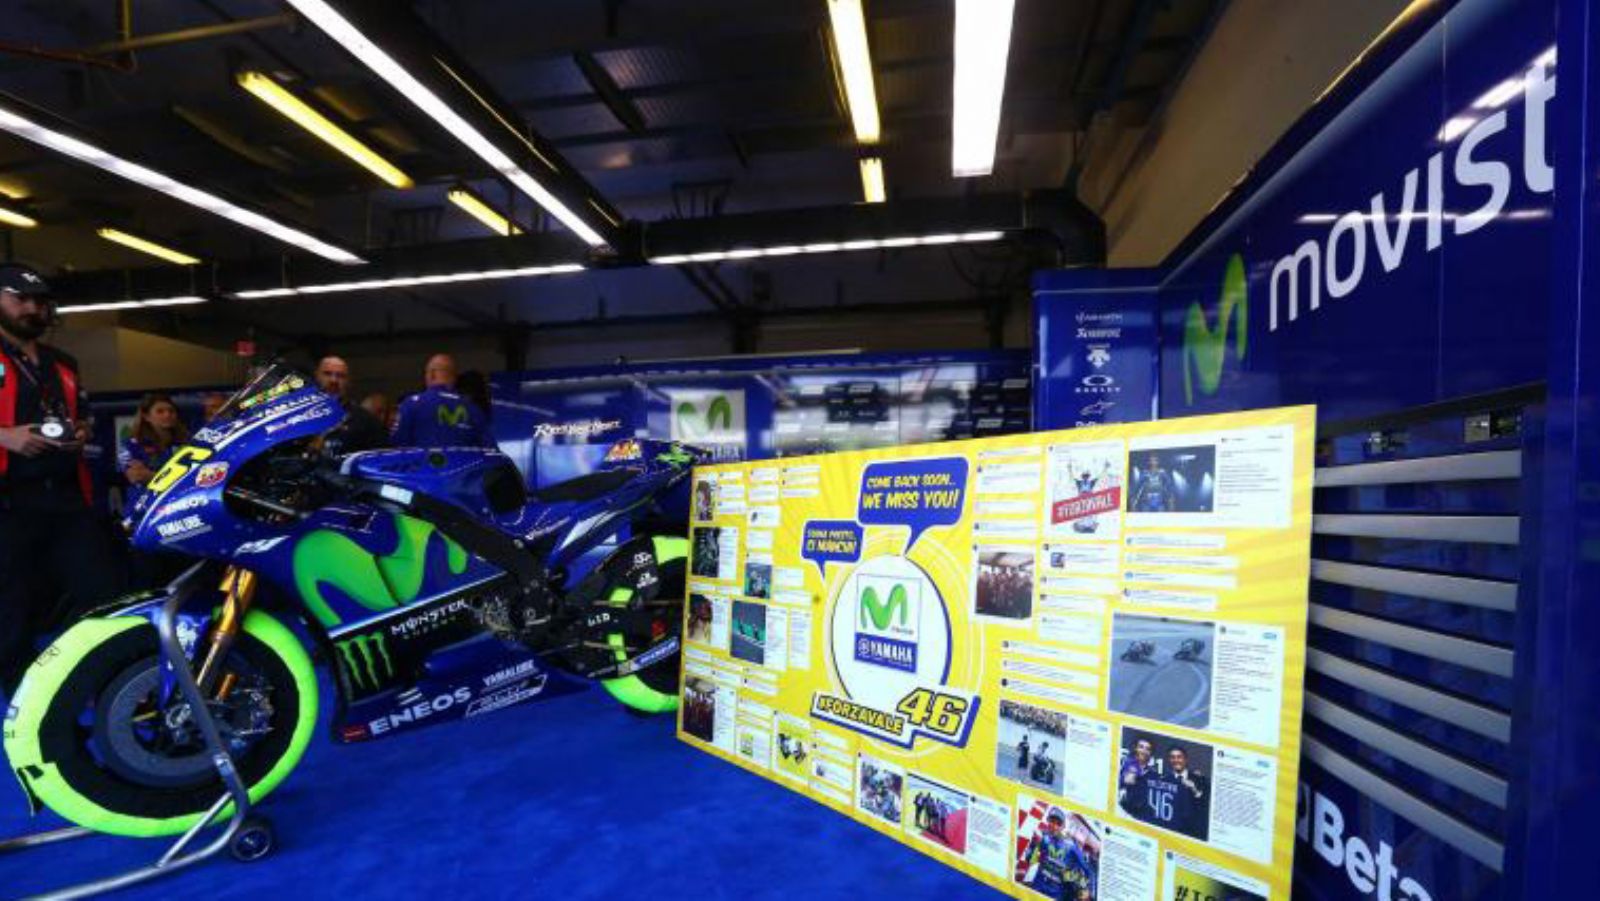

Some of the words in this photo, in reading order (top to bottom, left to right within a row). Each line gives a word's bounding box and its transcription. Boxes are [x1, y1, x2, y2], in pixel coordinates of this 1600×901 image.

[867, 475, 893, 489] COME
[894, 474, 920, 488] BACK
[862, 493, 882, 509] WE
[885, 490, 919, 510] MISS
[923, 488, 960, 509] YOU!
[870, 640, 913, 663] YAMAHA
[368, 686, 472, 736] ENEOS
[897, 687, 968, 736] 46
[1148, 788, 1174, 822] 46
